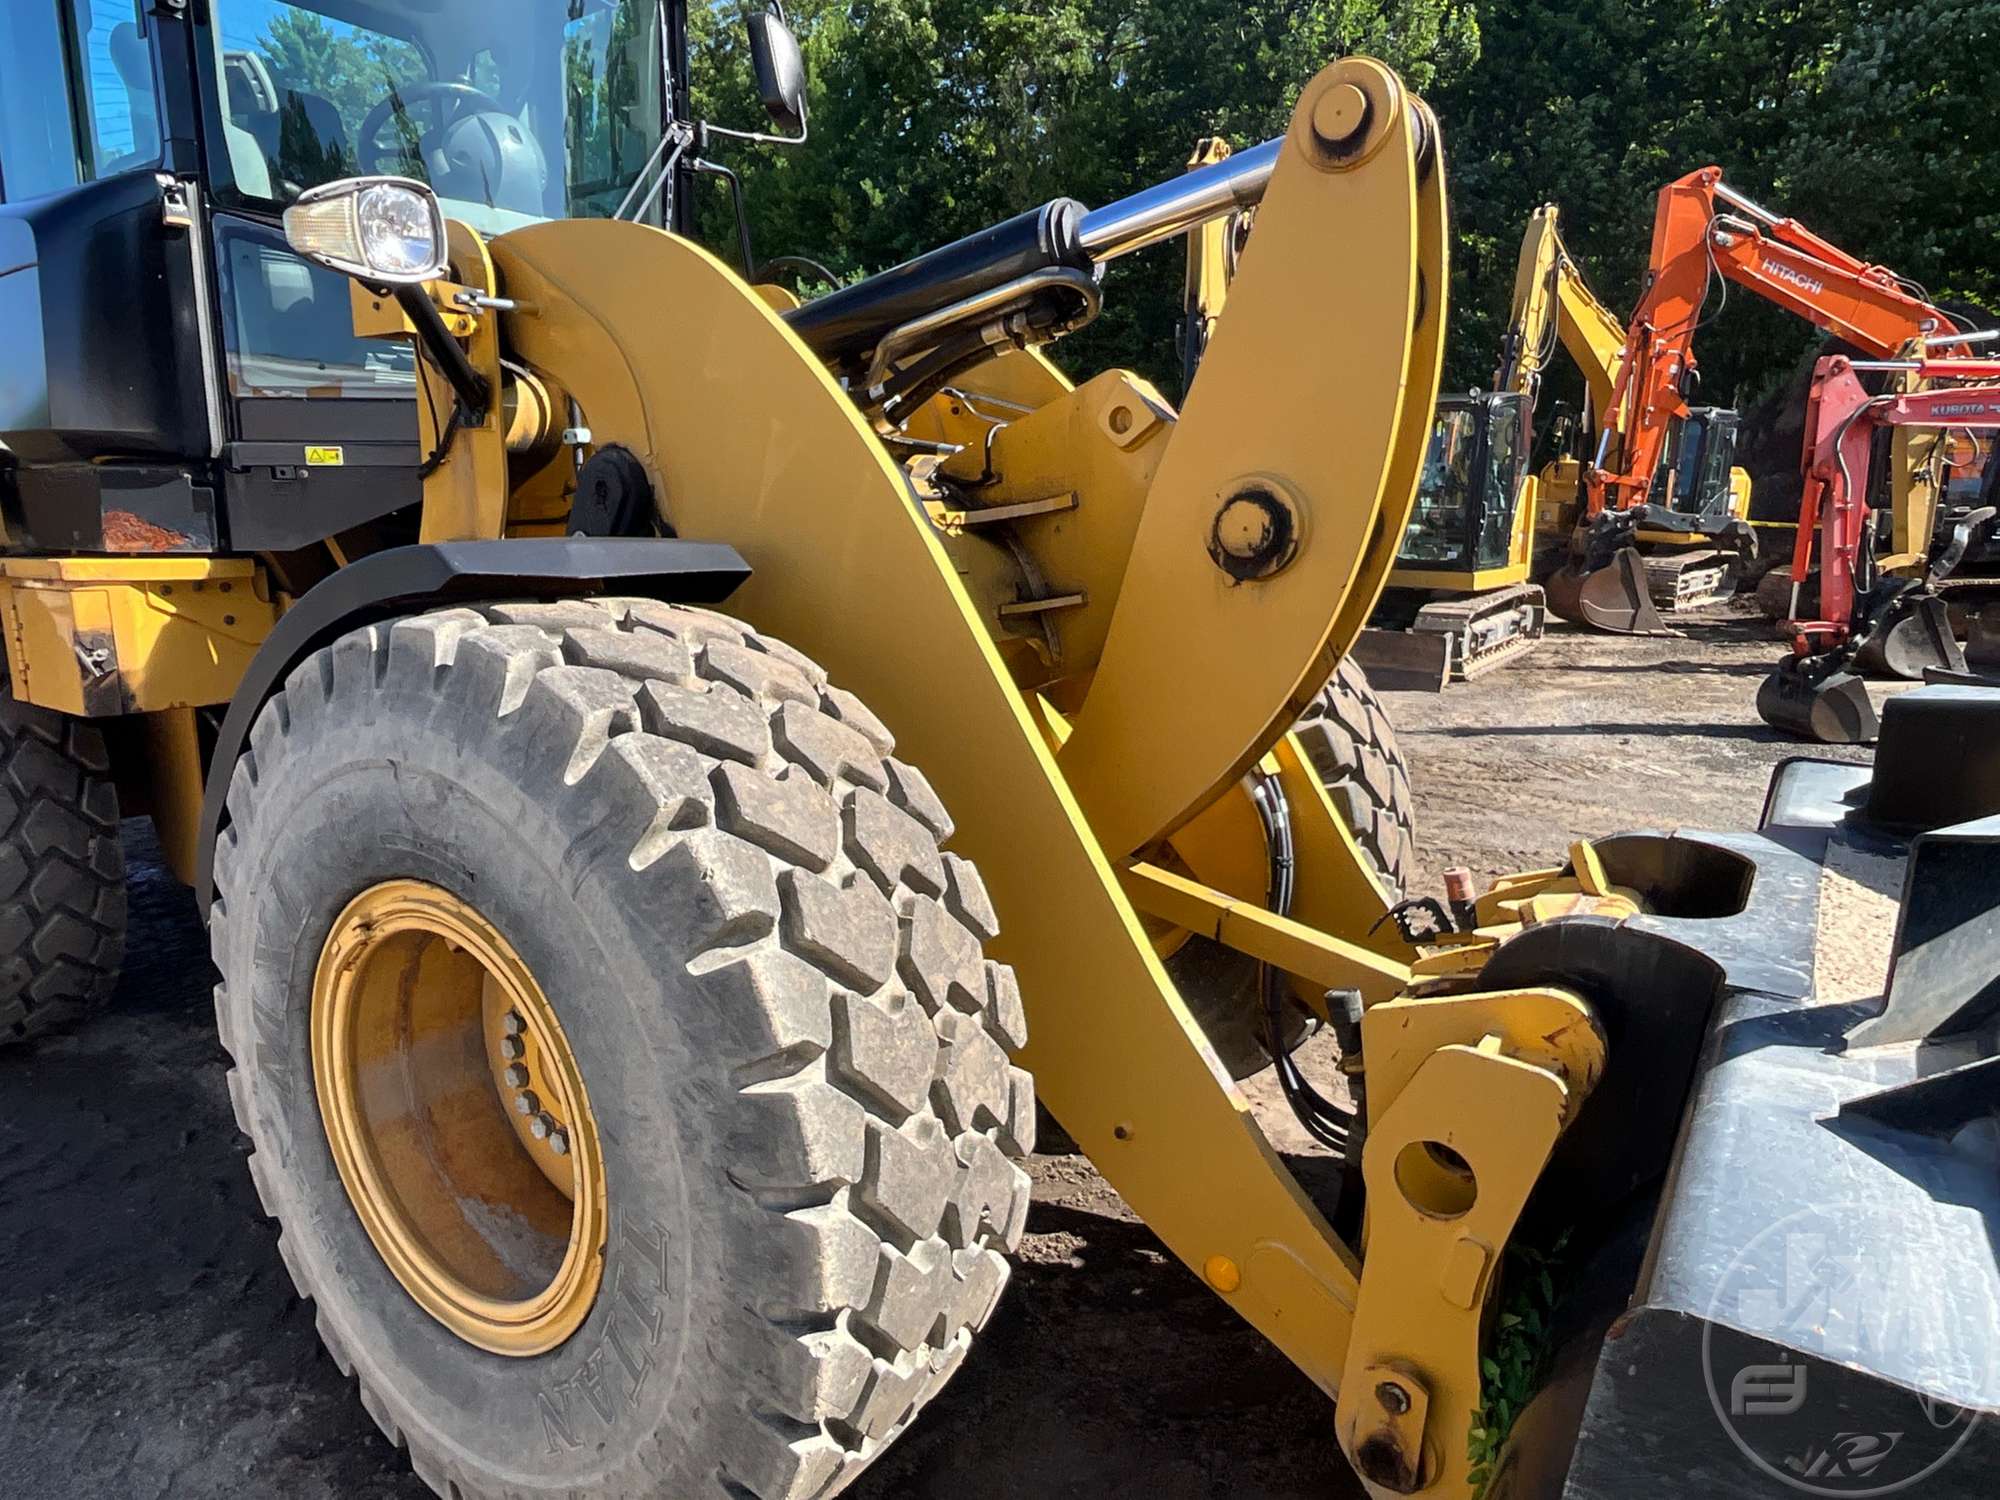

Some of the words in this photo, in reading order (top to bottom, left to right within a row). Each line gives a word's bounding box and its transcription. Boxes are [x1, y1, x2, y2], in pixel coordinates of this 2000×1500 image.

[1761, 258, 1823, 295] HITACHI
[1931, 404, 1985, 416] KUBOTA
[537, 1202, 672, 1456] TITAN
